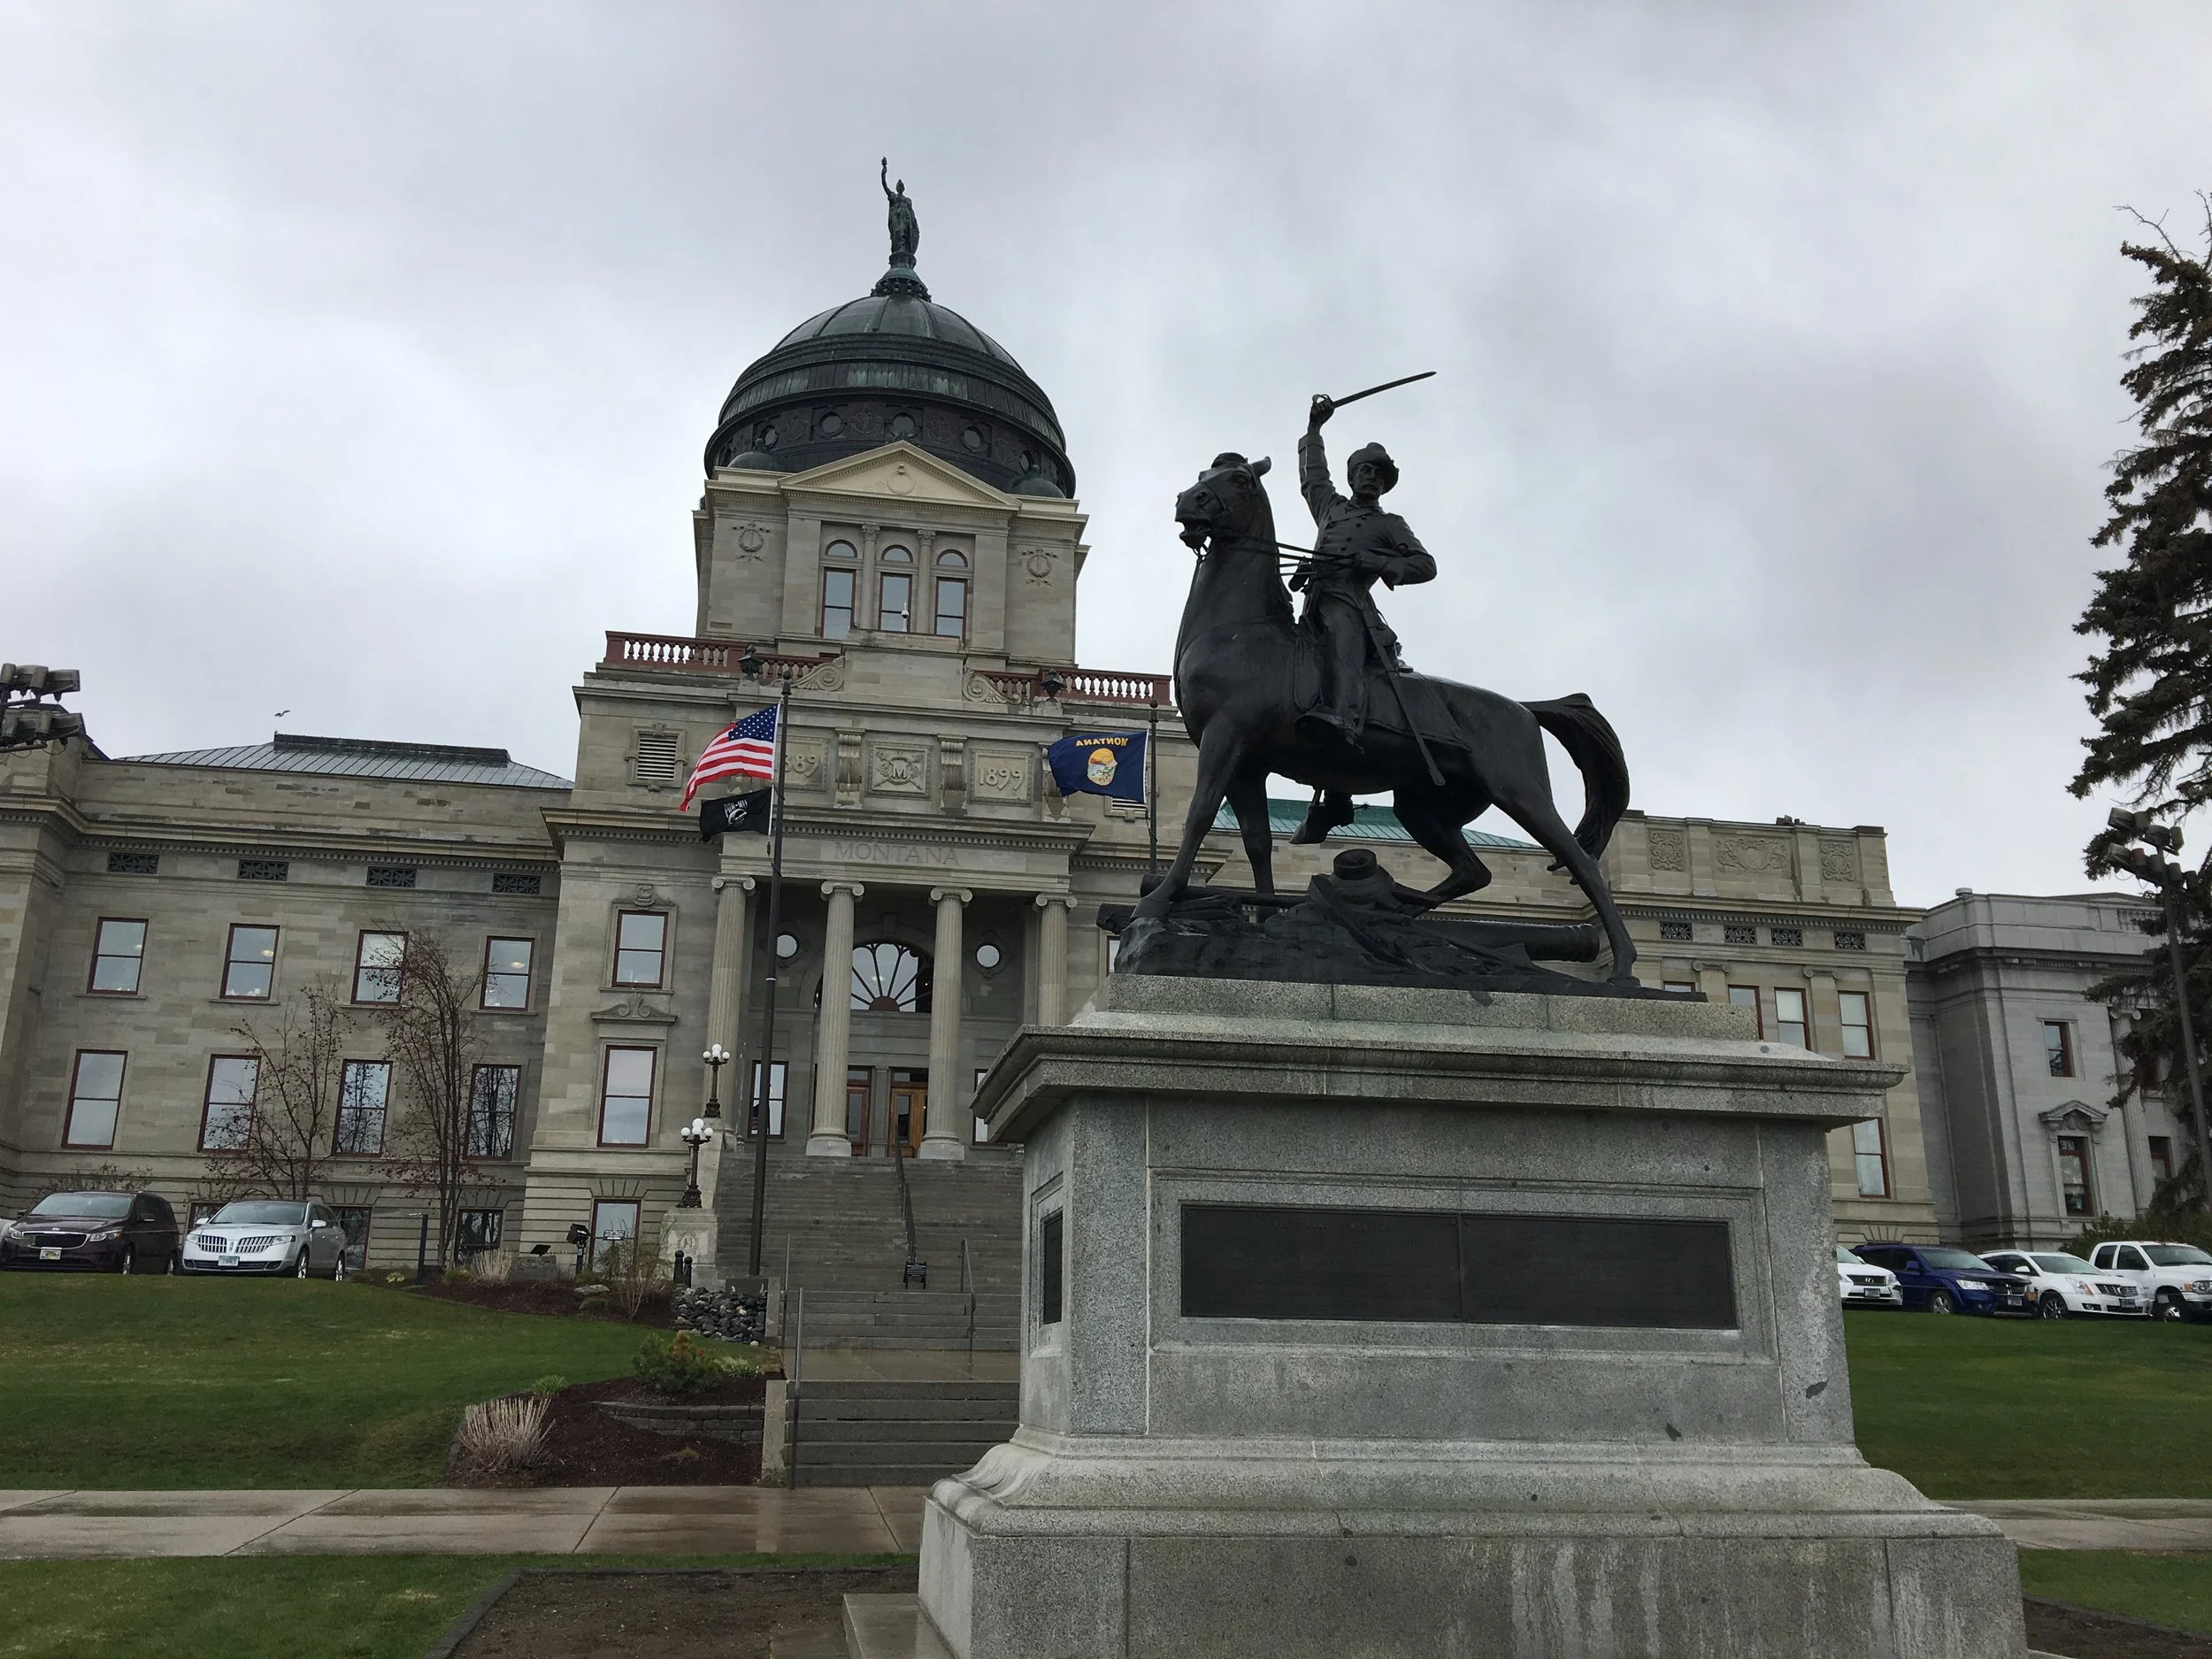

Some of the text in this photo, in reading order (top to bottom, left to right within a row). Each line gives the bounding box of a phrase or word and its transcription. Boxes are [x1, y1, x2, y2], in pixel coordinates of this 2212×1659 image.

[783, 754, 820, 779] 889
[979, 767, 1024, 792] 1899
[834, 841, 960, 865] MONTANA
